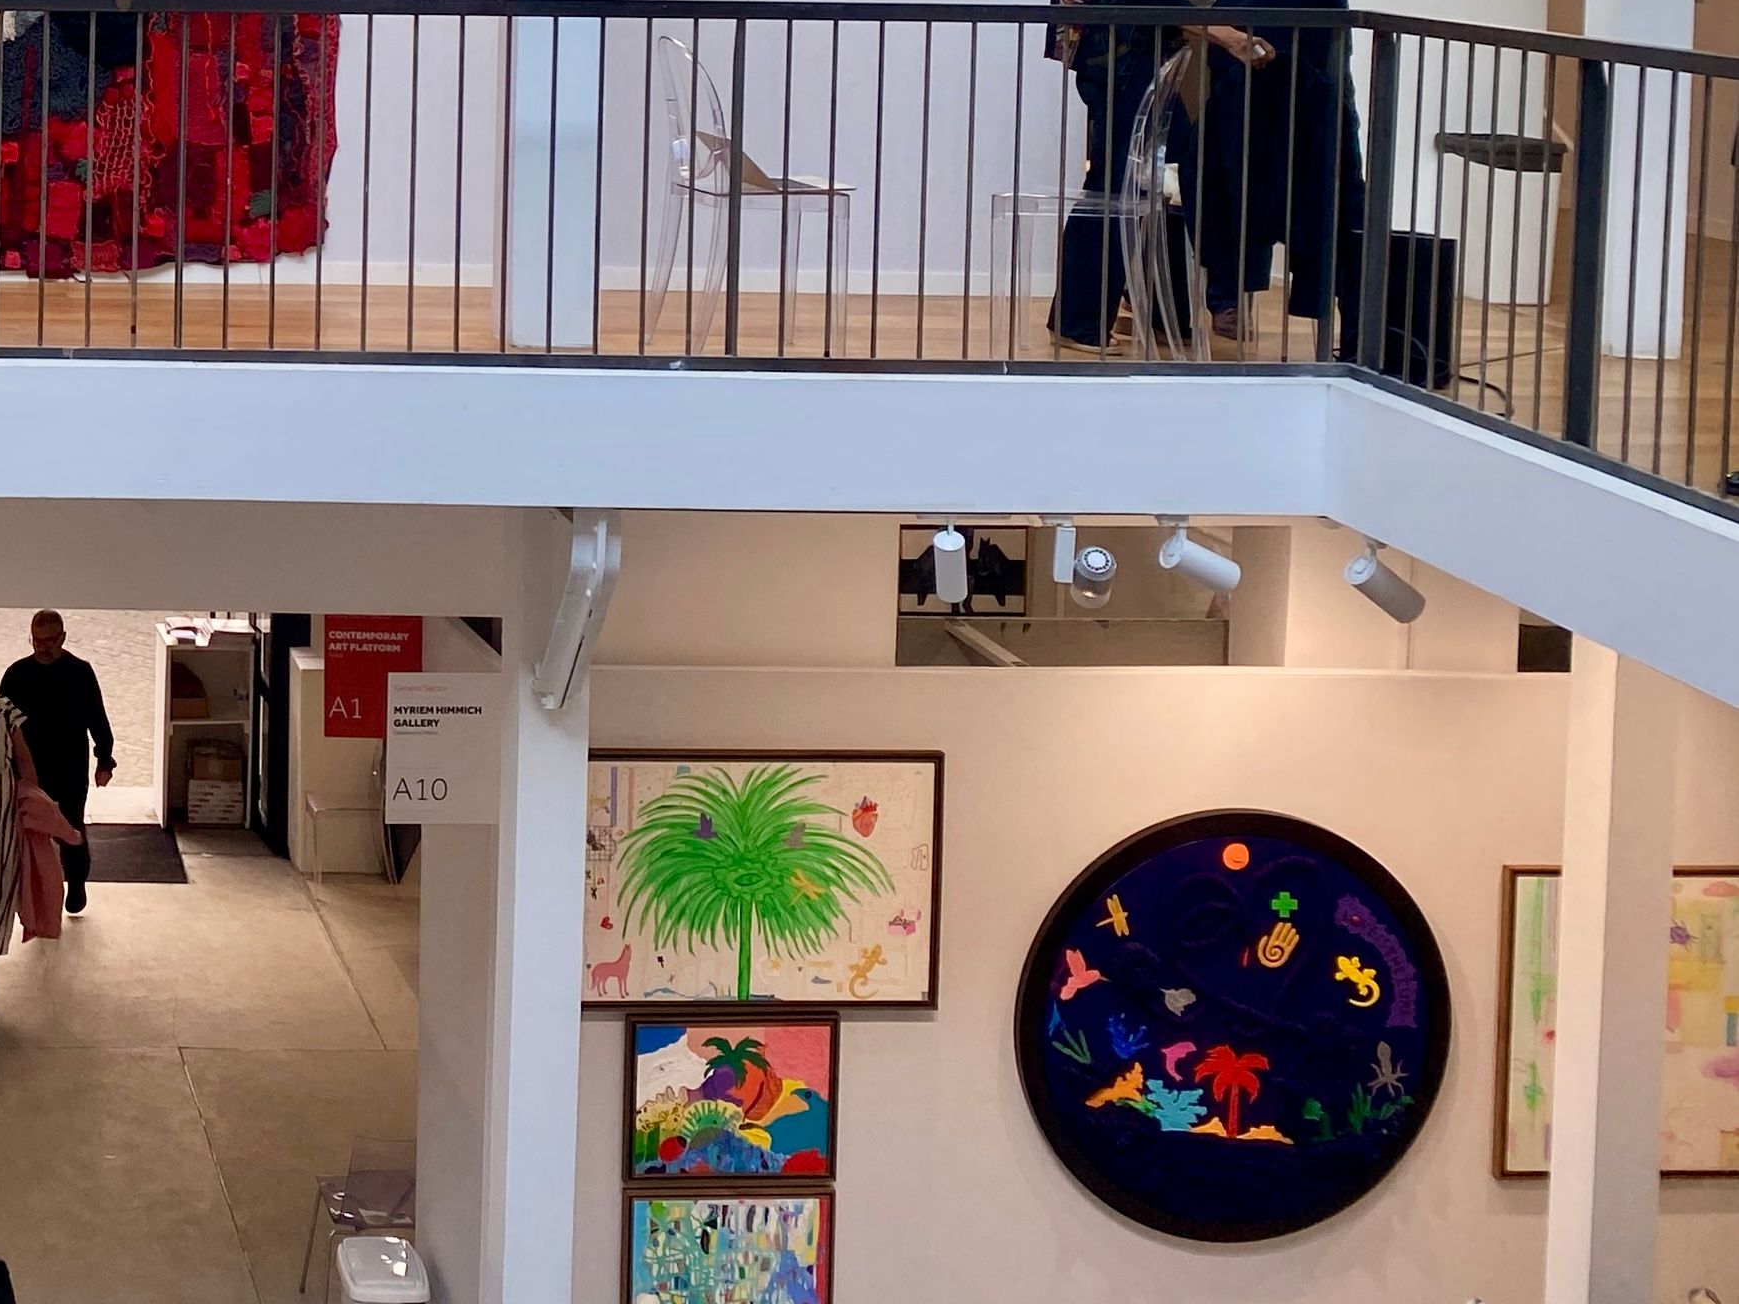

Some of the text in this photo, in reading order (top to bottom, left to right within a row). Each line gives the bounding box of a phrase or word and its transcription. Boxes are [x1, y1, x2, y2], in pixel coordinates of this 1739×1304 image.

[328, 631, 409, 641] CONTEMPORARY
[328, 642, 401, 653] ART PLATFORM
[328, 696, 363, 719] A1
[393, 706, 483, 715] MYRIEM HIMMICH
[393, 719, 441, 728] GALLERY
[392, 777, 448, 801] A10
